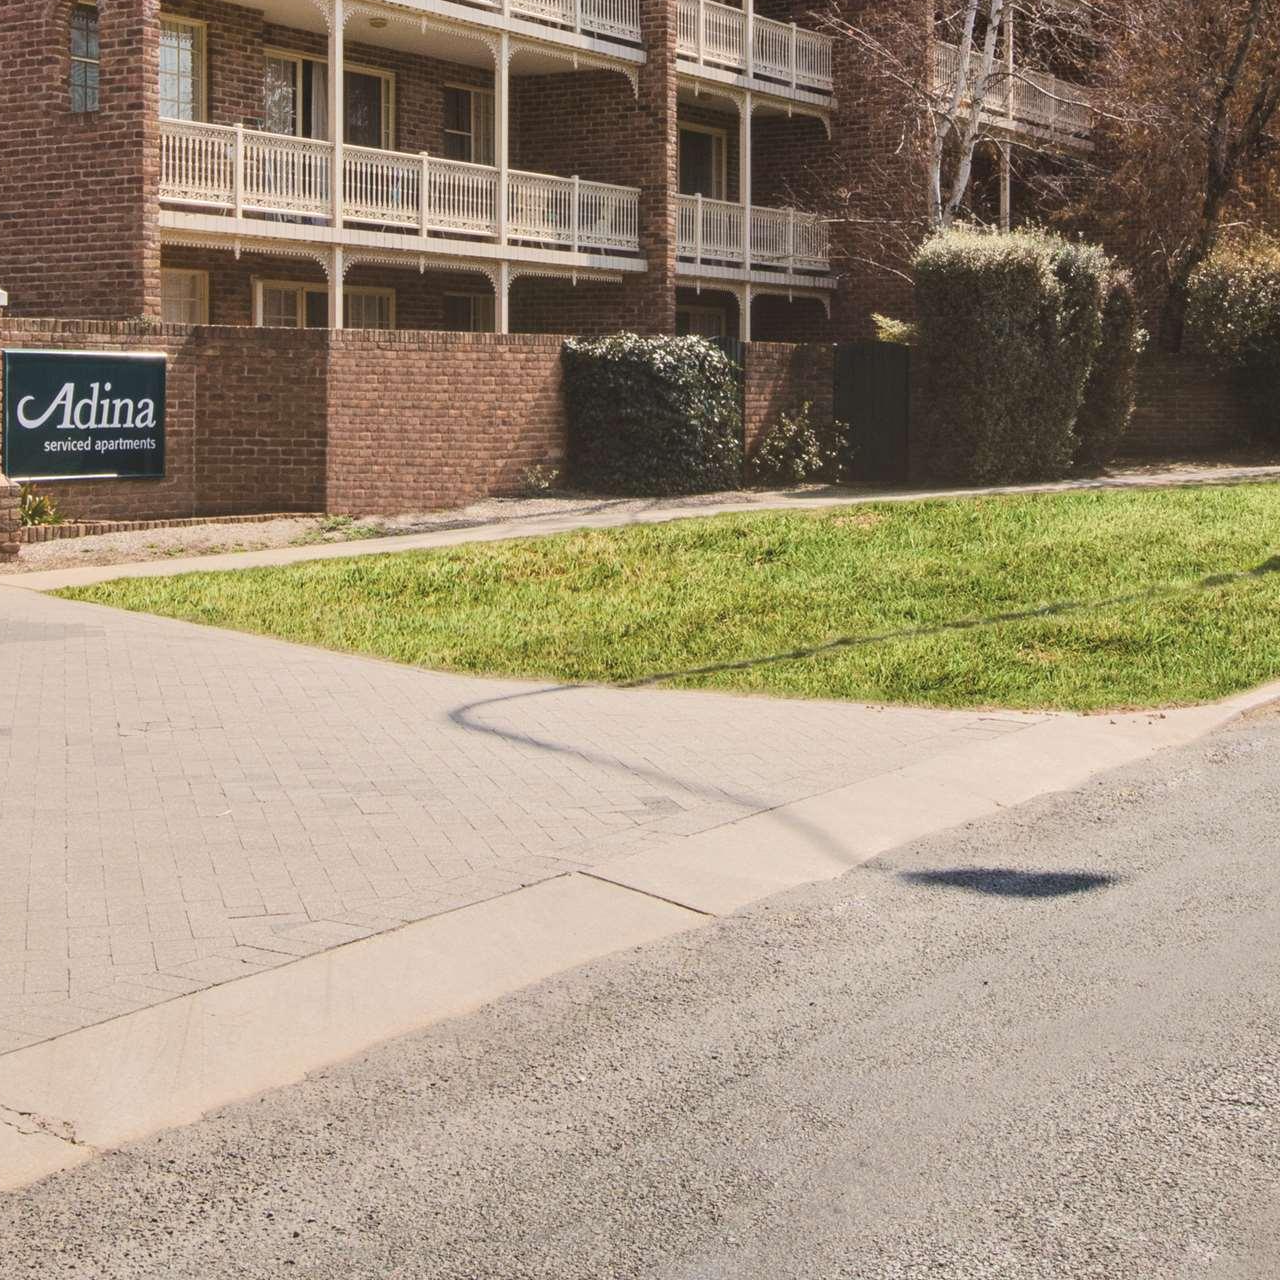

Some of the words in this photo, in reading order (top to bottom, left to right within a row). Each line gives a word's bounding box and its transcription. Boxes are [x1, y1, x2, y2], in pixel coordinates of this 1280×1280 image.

[16, 381, 156, 430] Adina
[43, 436, 91, 452] serviced
[94, 437, 156, 454] apartments
